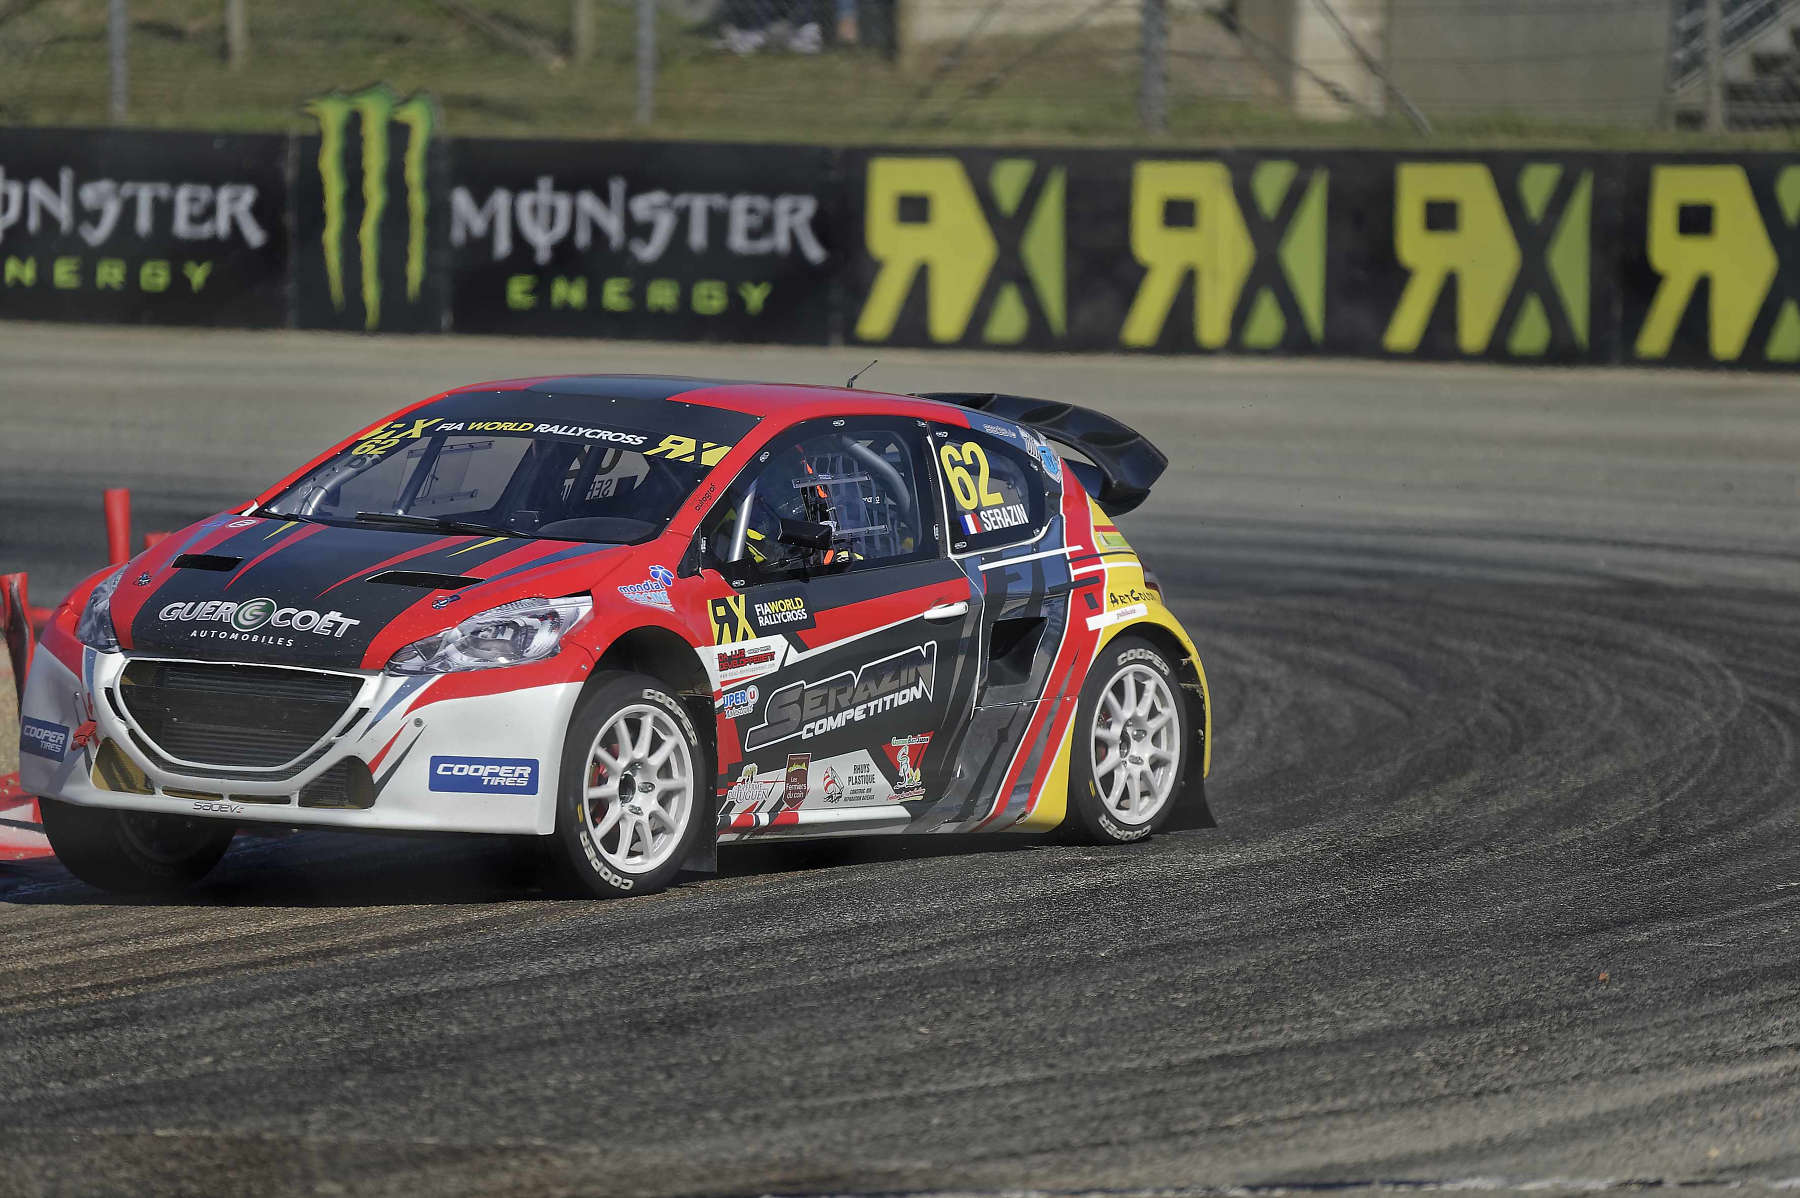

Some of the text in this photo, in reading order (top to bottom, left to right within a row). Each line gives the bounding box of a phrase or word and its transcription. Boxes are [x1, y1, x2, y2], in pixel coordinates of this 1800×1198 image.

[450, 175, 828, 265] MONSTER
[855, 157, 1067, 344] RX
[1119, 160, 1330, 349] RX
[1382, 162, 1594, 355] RX
[506, 274, 773, 315] ENERGY
[352, 438, 400, 456] 62
[434, 421, 649, 446] FIA WORLD RALLYCROSS
[940, 441, 1004, 511] 62
[980, 503, 1030, 533] SERAZIN
[617, 580, 666, 593] mondial
[758, 609, 808, 627] RALLYCROSS
[189, 629, 295, 648] AUTOMOBILES
[718, 651, 776, 672] DEVELOPPEMENT
[1116, 648, 1171, 677] COOPER
[745, 642, 937, 752] SERAZIN
[641, 688, 699, 748] COOPER
[801, 685, 926, 740] COMPETITION
[23, 724, 66, 745] COOPER
[40, 740, 63, 754] TIRES
[436, 763, 532, 778] COOPER
[481, 776, 529, 787] TIRES
[847, 774, 876, 786] PLASTIQUE
[1098, 813, 1152, 842] COOPER
[579, 831, 635, 891] COOPER
